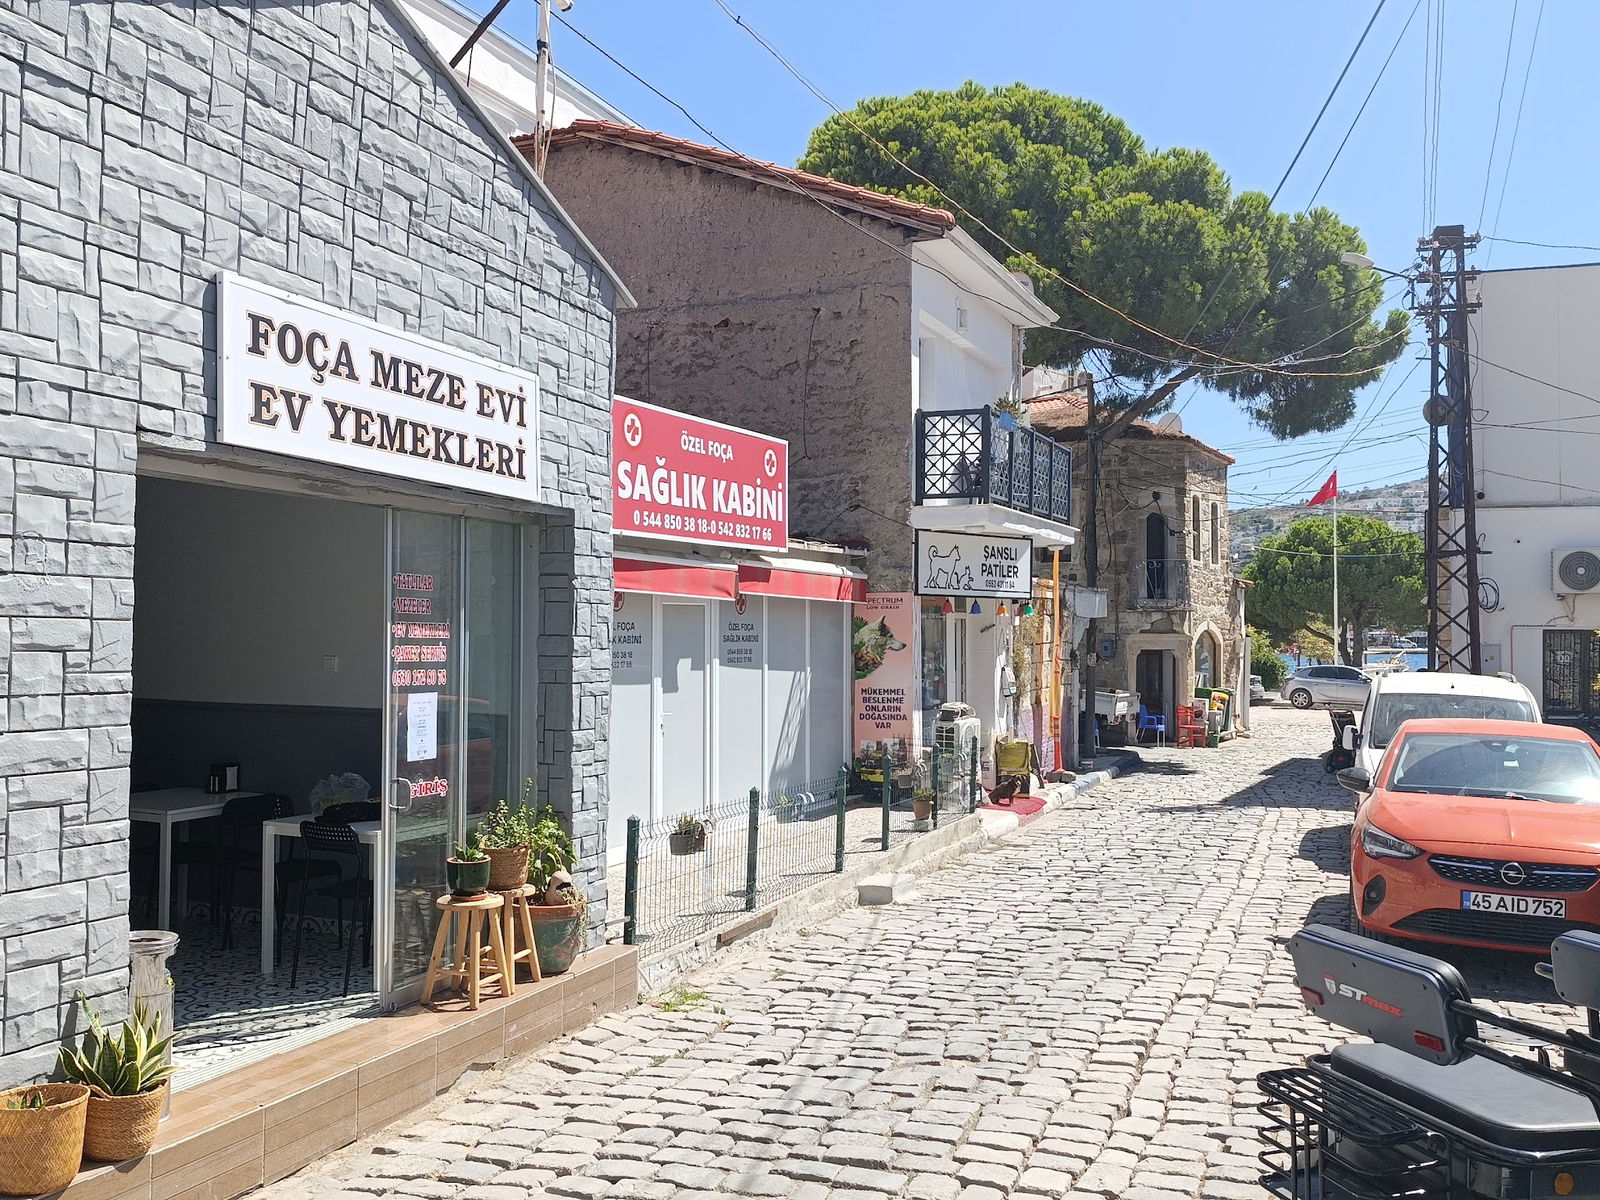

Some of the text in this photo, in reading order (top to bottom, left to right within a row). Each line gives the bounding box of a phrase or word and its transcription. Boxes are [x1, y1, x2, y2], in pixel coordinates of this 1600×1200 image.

[246, 310, 528, 428] FOÇA MEZE EVİ
[249, 381, 528, 481] EV YEMEKLERİ
[681, 430, 734, 463] ÖZEL FOÇA
[617, 455, 783, 522] SAĞLIK KABİNİ
[633, 510, 772, 541] 0 544 850 38 18-0 542 832 17 66
[984, 545, 1018, 561] ŞANSLI
[981, 561, 1019, 578] PATİLER
[397, 573, 433, 591] TATLILAR
[396, 597, 431, 614] MEZELER
[617, 622, 635, 633] FOÇA
[618, 634, 642, 644] KABİNİ
[861, 687, 906, 696] MÜKEMMEL
[860, 713, 908, 721] DOĞASINDA
[865, 705, 902, 713] ONLARIN
[410, 776, 448, 797] GİRİŞ
[1472, 894, 1564, 917] 45 AID 752
